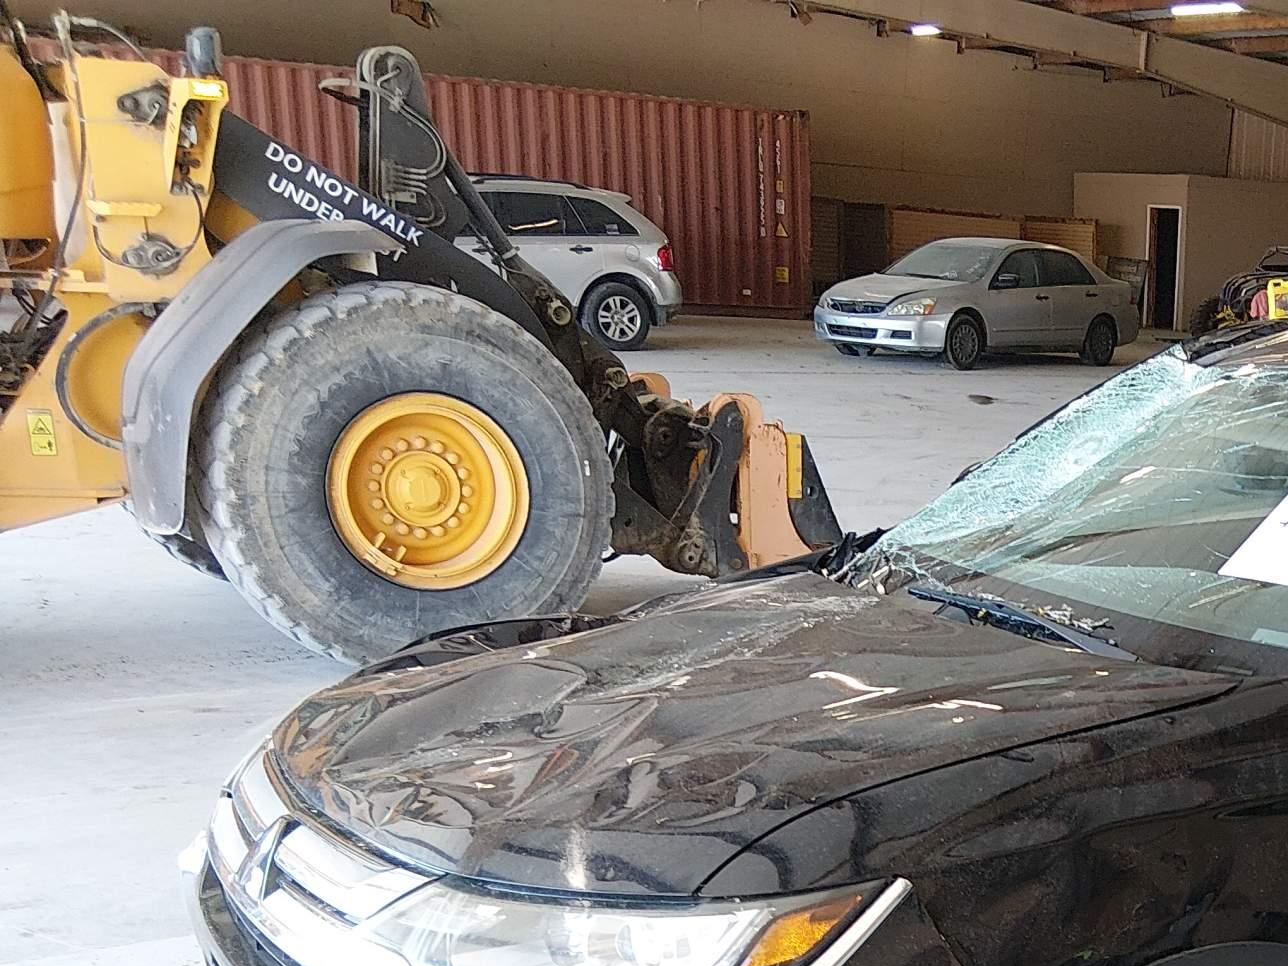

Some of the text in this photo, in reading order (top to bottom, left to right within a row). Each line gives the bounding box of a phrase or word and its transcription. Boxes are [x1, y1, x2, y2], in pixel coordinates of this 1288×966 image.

[264, 141, 424, 247] DO NOT WALK
